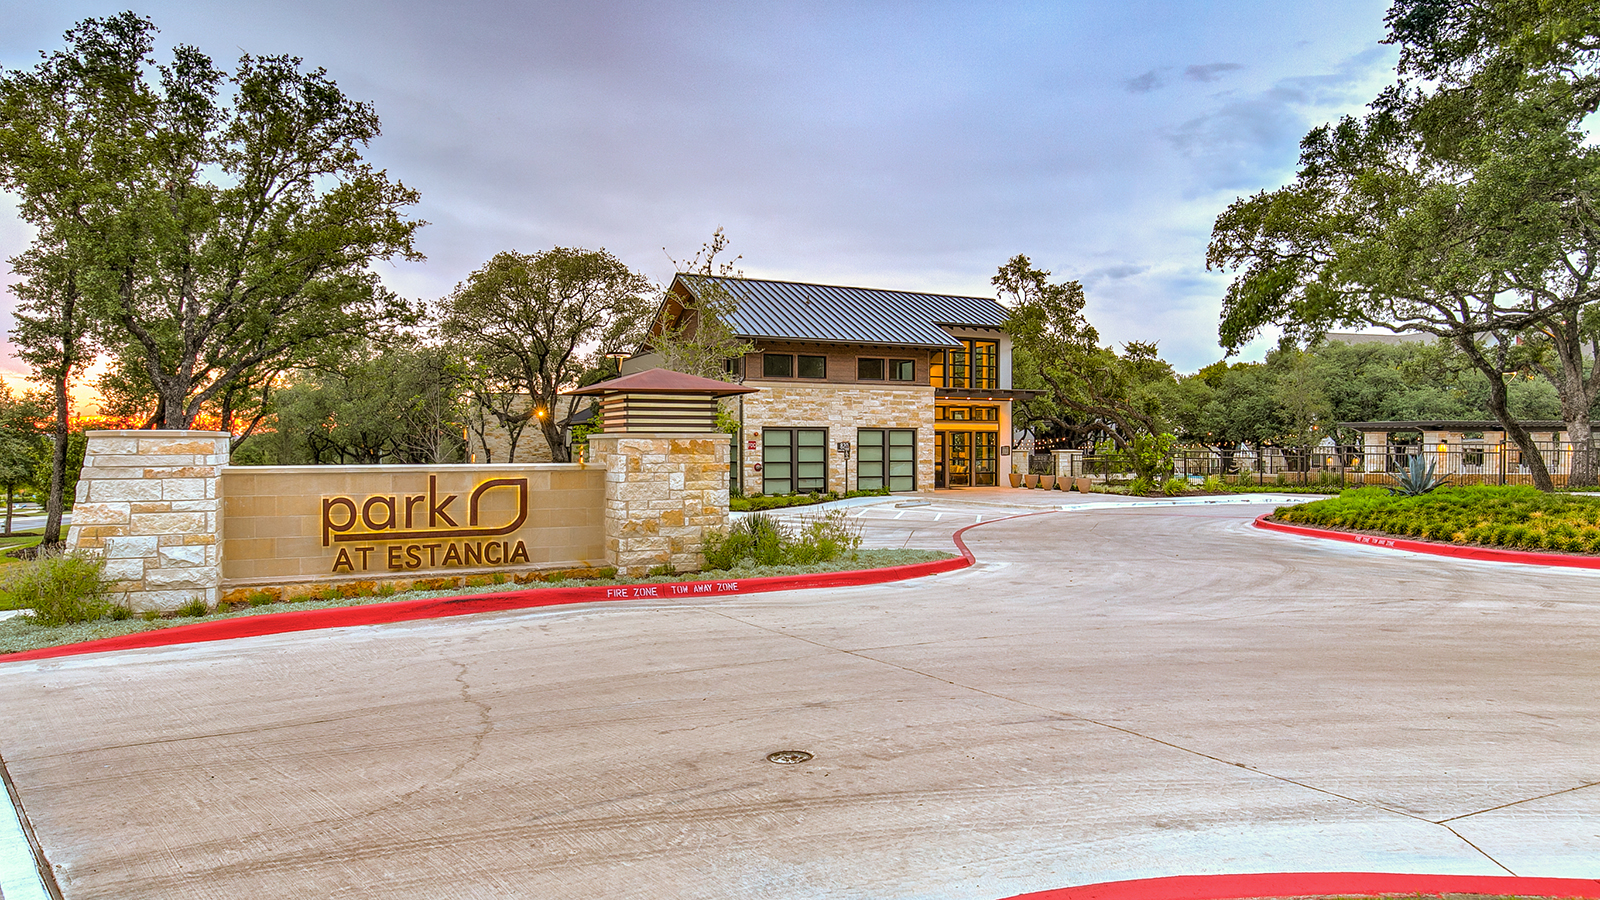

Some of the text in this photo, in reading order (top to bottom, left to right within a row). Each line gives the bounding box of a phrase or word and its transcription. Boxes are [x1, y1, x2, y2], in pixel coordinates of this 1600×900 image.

[322, 475, 459, 546] park
[332, 541, 530, 572] AT ESTANCIA
[607, 582, 739, 598] FIRE ZONE TOW AWAY ZONE
